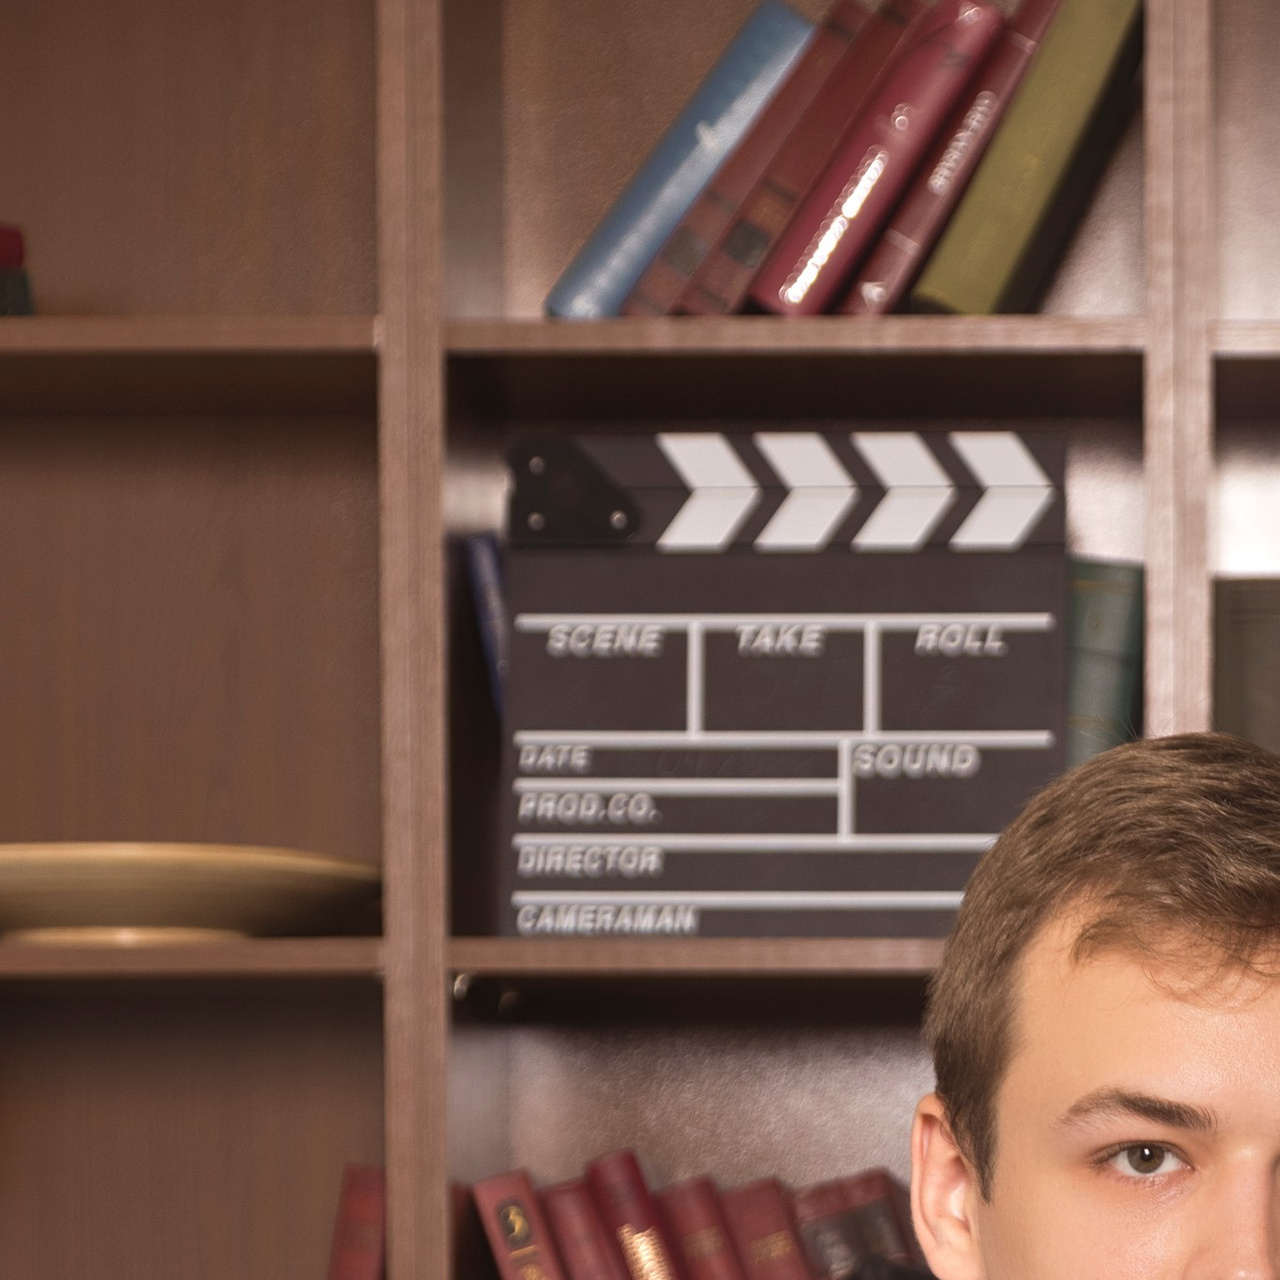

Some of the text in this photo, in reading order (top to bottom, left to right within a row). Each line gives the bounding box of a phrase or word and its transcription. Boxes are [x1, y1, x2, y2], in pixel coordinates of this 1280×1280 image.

[547, 624, 664, 657] SCENE
[736, 624, 825, 656] TAKE
[915, 624, 1008, 656] ROLL
[518, 745, 592, 773] DATE
[853, 744, 980, 778] SOUND
[517, 847, 663, 877] DIRECTOR
[517, 904, 697, 934] CAMERAMAN
